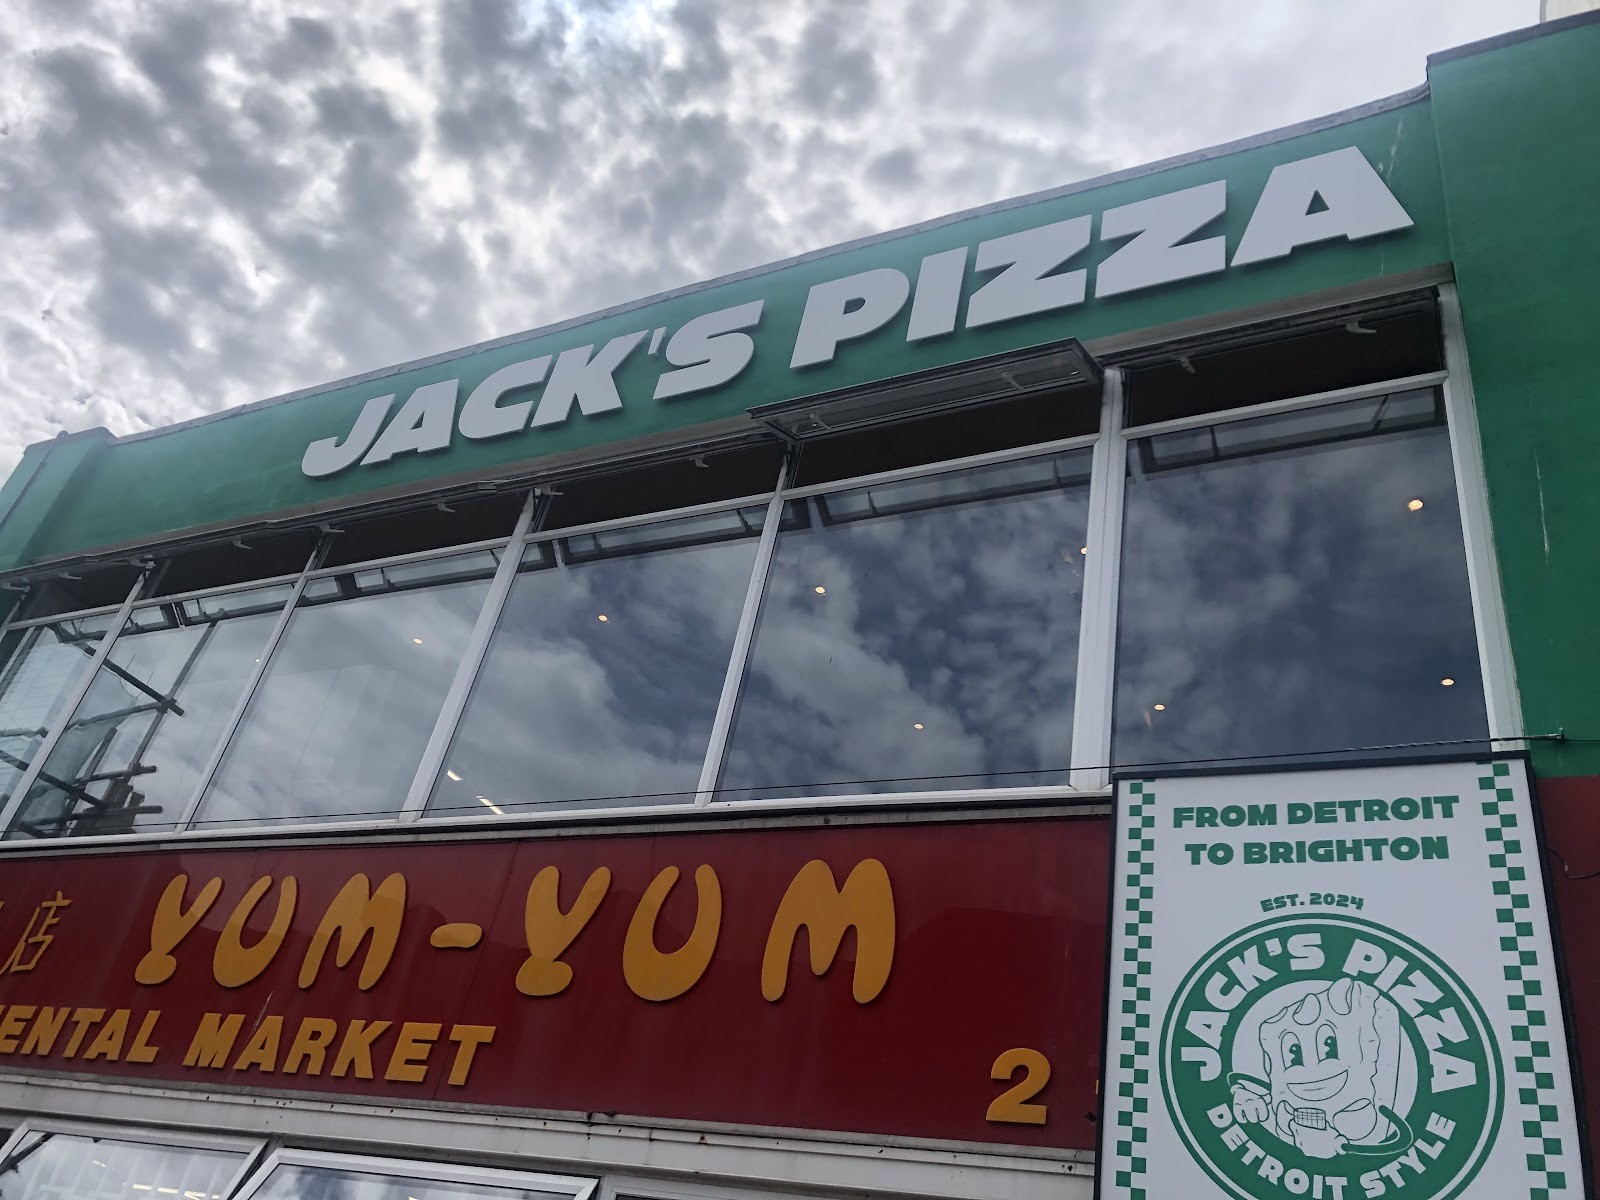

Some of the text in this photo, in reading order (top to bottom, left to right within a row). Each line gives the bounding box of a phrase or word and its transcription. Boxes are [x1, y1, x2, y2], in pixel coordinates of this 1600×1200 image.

[302, 145, 1415, 477] JACK'S PIZZA
[1173, 795, 1460, 828] FROM DETROIT
[1184, 835, 1450, 866] TO BRIGHTON
[0, 890, 72, 975] 店
[134, 857, 897, 1005] YUM-YUM
[1260, 892, 1365, 912] EST. 2024
[0, 1004, 497, 1086] ENTAL MARKET
[1181, 932, 1478, 1094] JACK'S PIZZA
[986, 1047, 1051, 1125] 2
[1206, 1103, 1457, 1200] DETROIT STYLE
